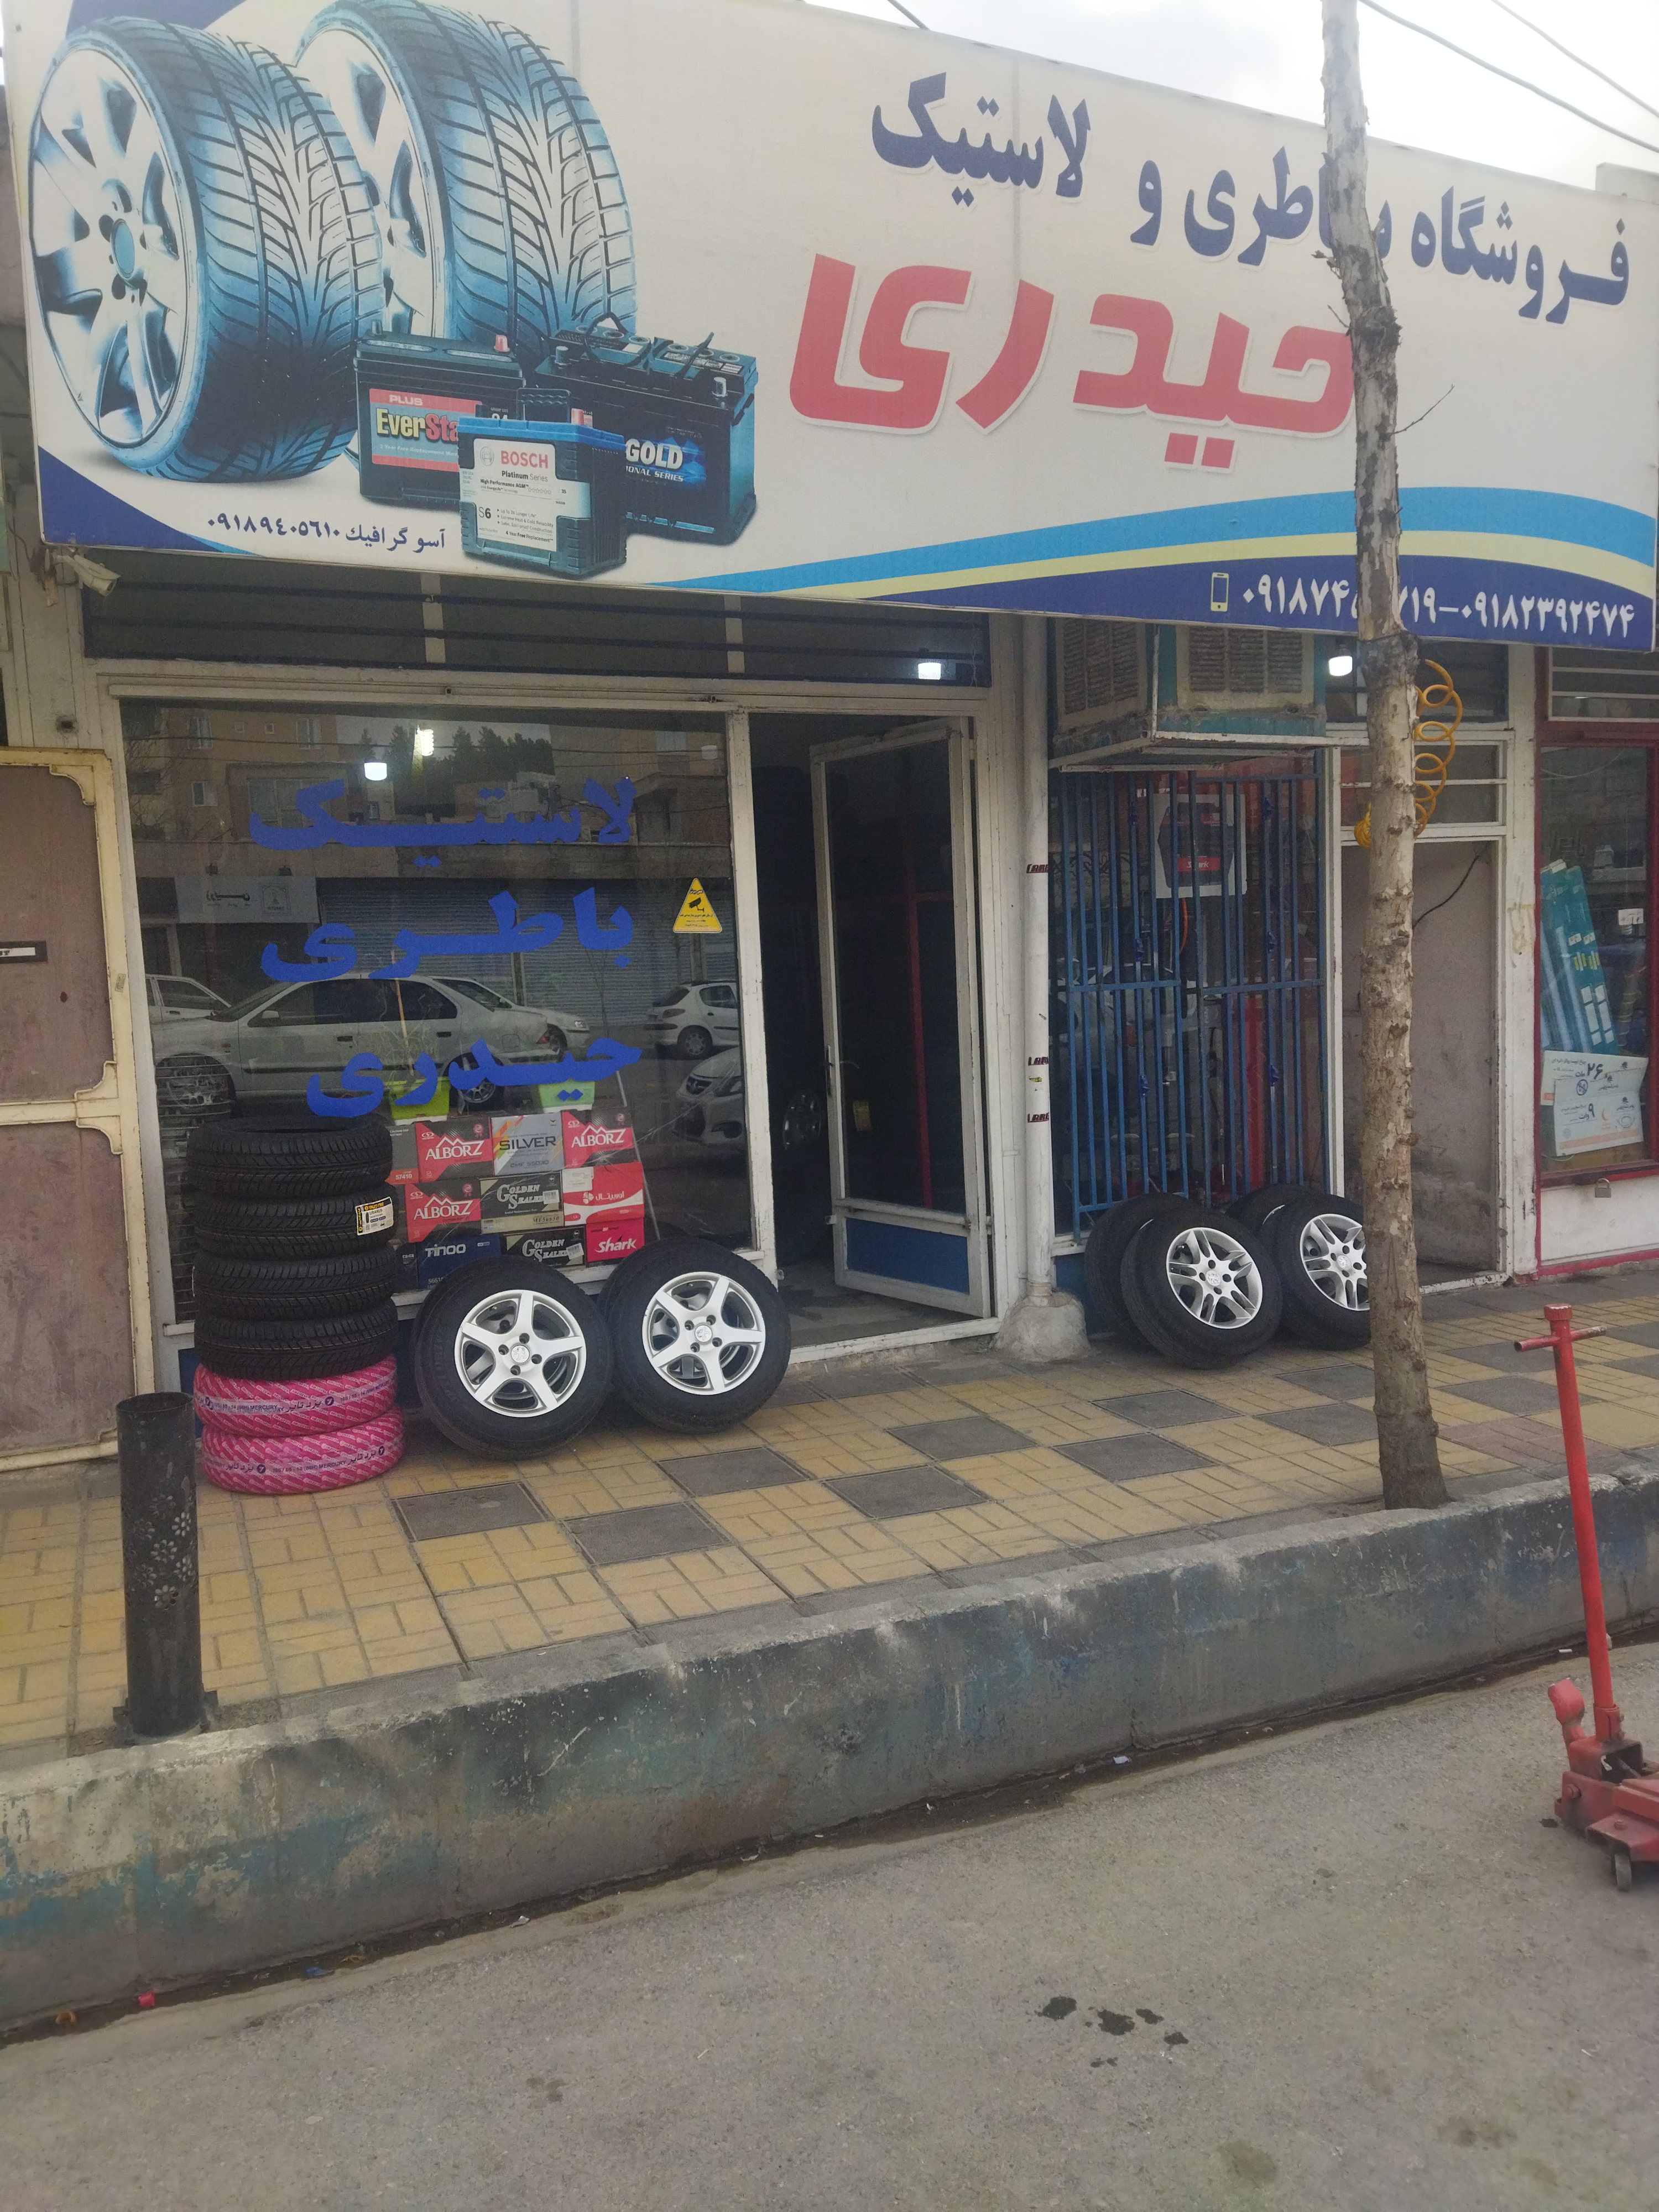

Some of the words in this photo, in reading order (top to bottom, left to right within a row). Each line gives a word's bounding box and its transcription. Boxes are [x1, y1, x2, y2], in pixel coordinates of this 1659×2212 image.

[872, 71, 1091, 208] لاستیک
[1130, 159, 1163, 246] و
[1183, 145, 1392, 267] اطری
[1410, 185, 1630, 325] فروشگاه
[789, 253, 1355, 469] حیدری
[389, 394, 423, 406] PLUS
[375, 407, 459, 443] EverSta
[500, 450, 549, 469] BOSCH
[625, 438, 684, 470] GOLD
[489, 479, 515, 488] Performance
[501, 470, 529, 480] Platinum
[529, 473, 548, 482] Series
[654, 471, 685, 482] SERIES
[478, 506, 492, 519] S6
[249, 776, 637, 868] لاستیک
[260, 887, 634, 983] باطری
[306, 1037, 643, 1118] حیدری
[499, 1136, 557, 1150] SILVER
[571, 1127, 627, 1148] ALBORZ
[425, 1138, 485, 1161] ALBORZ
[497, 1184, 541, 1202] GOLDEN
[414, 1198, 474, 1220] ALBORZ
[522, 1239, 565, 1257] GOLDEN
[594, 1237, 637, 1253] Shark
[319, 1460, 347, 1469] MERCURY
